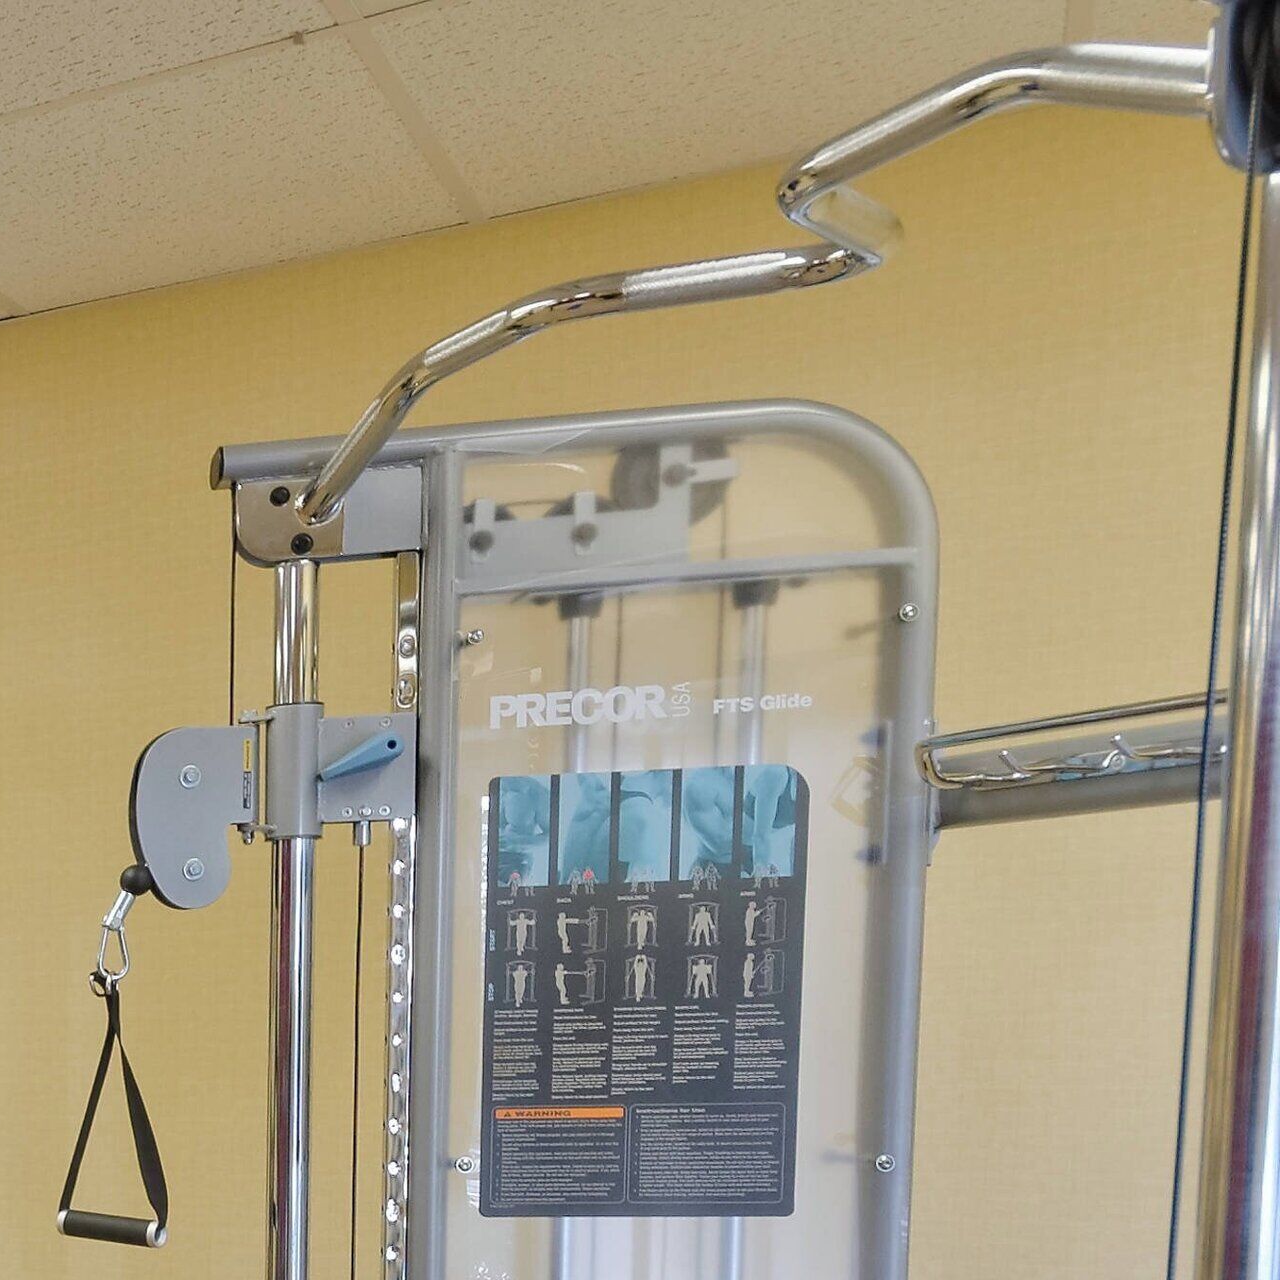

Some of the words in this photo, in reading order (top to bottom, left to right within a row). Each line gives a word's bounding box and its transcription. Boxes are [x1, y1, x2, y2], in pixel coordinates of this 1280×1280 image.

[490, 684, 668, 730] PRECOR
[671, 682, 691, 718] USA
[713, 697, 754, 715] FTS
[760, 694, 813, 711] Glide
